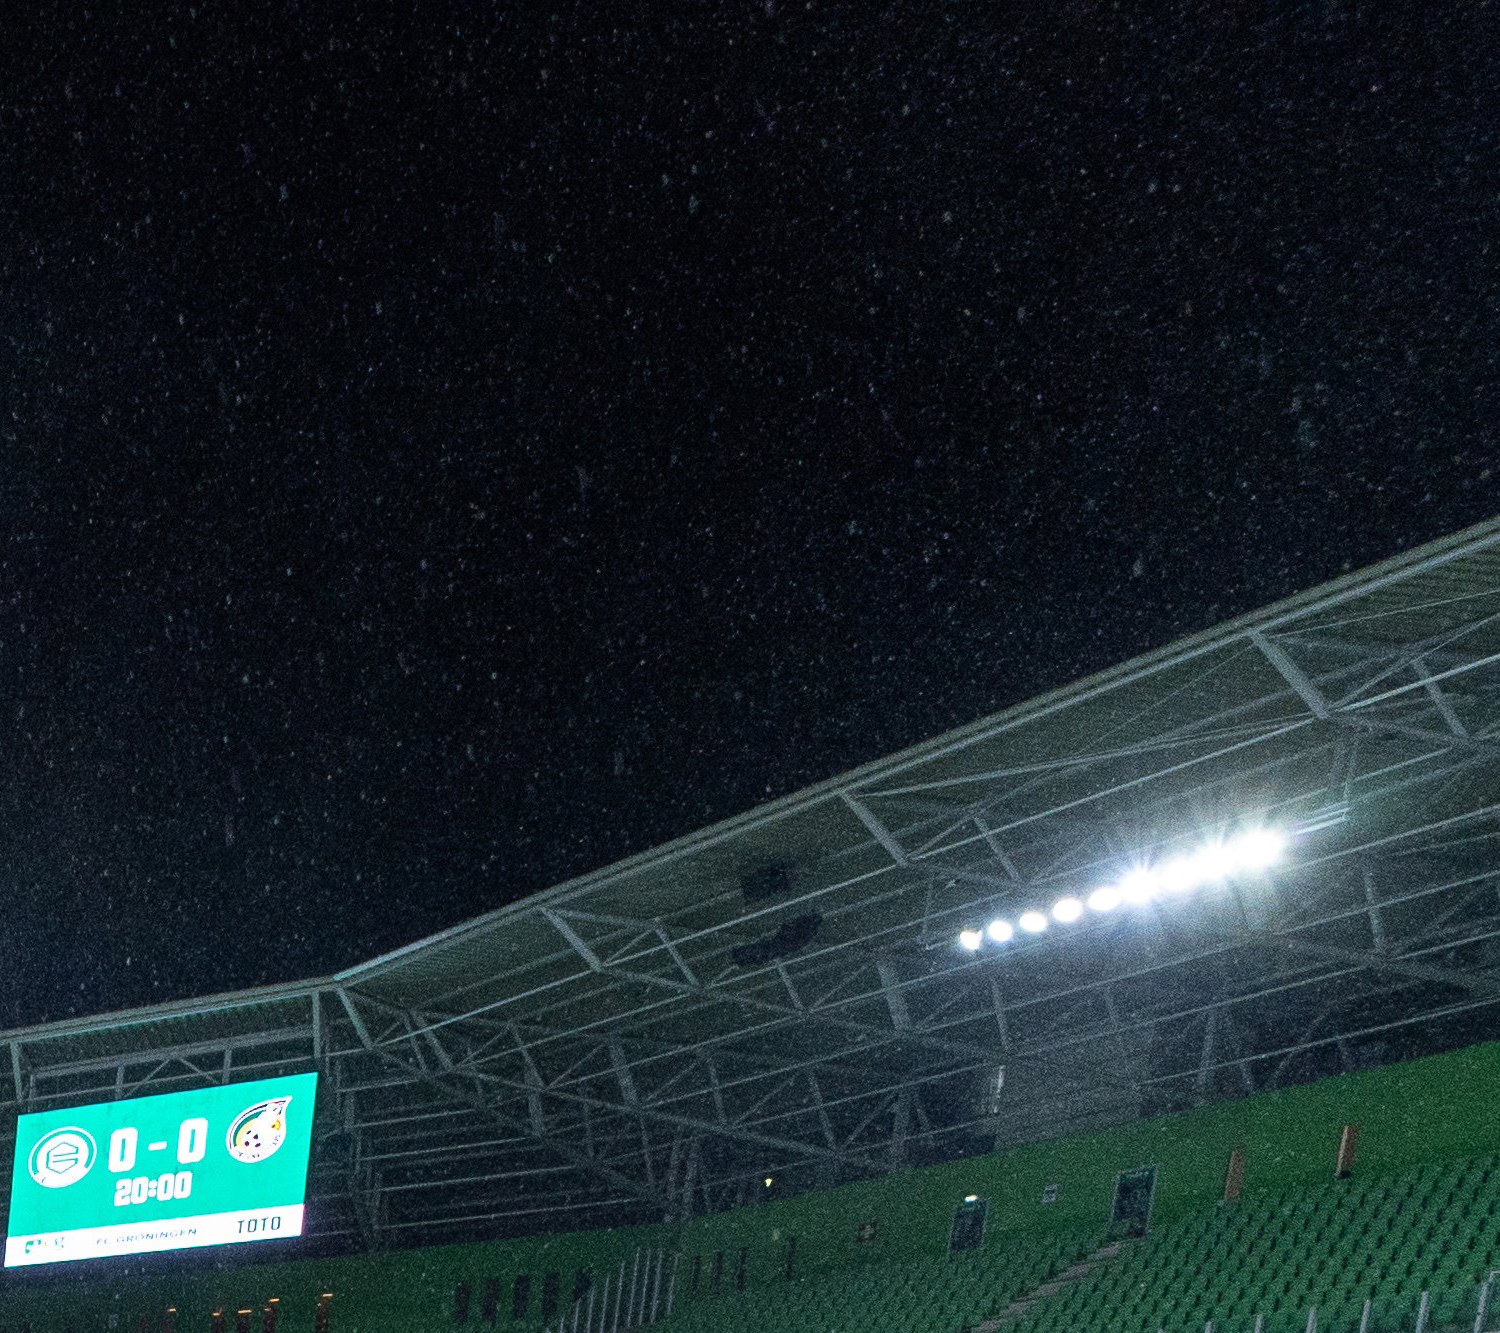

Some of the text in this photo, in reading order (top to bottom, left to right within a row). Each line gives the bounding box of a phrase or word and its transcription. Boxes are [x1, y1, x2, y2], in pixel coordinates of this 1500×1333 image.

[108, 1126, 139, 1173] 0
[177, 1117, 209, 1165] 0
[113, 1170, 193, 1207] 20:00
[237, 1216, 282, 1234] TOTO
